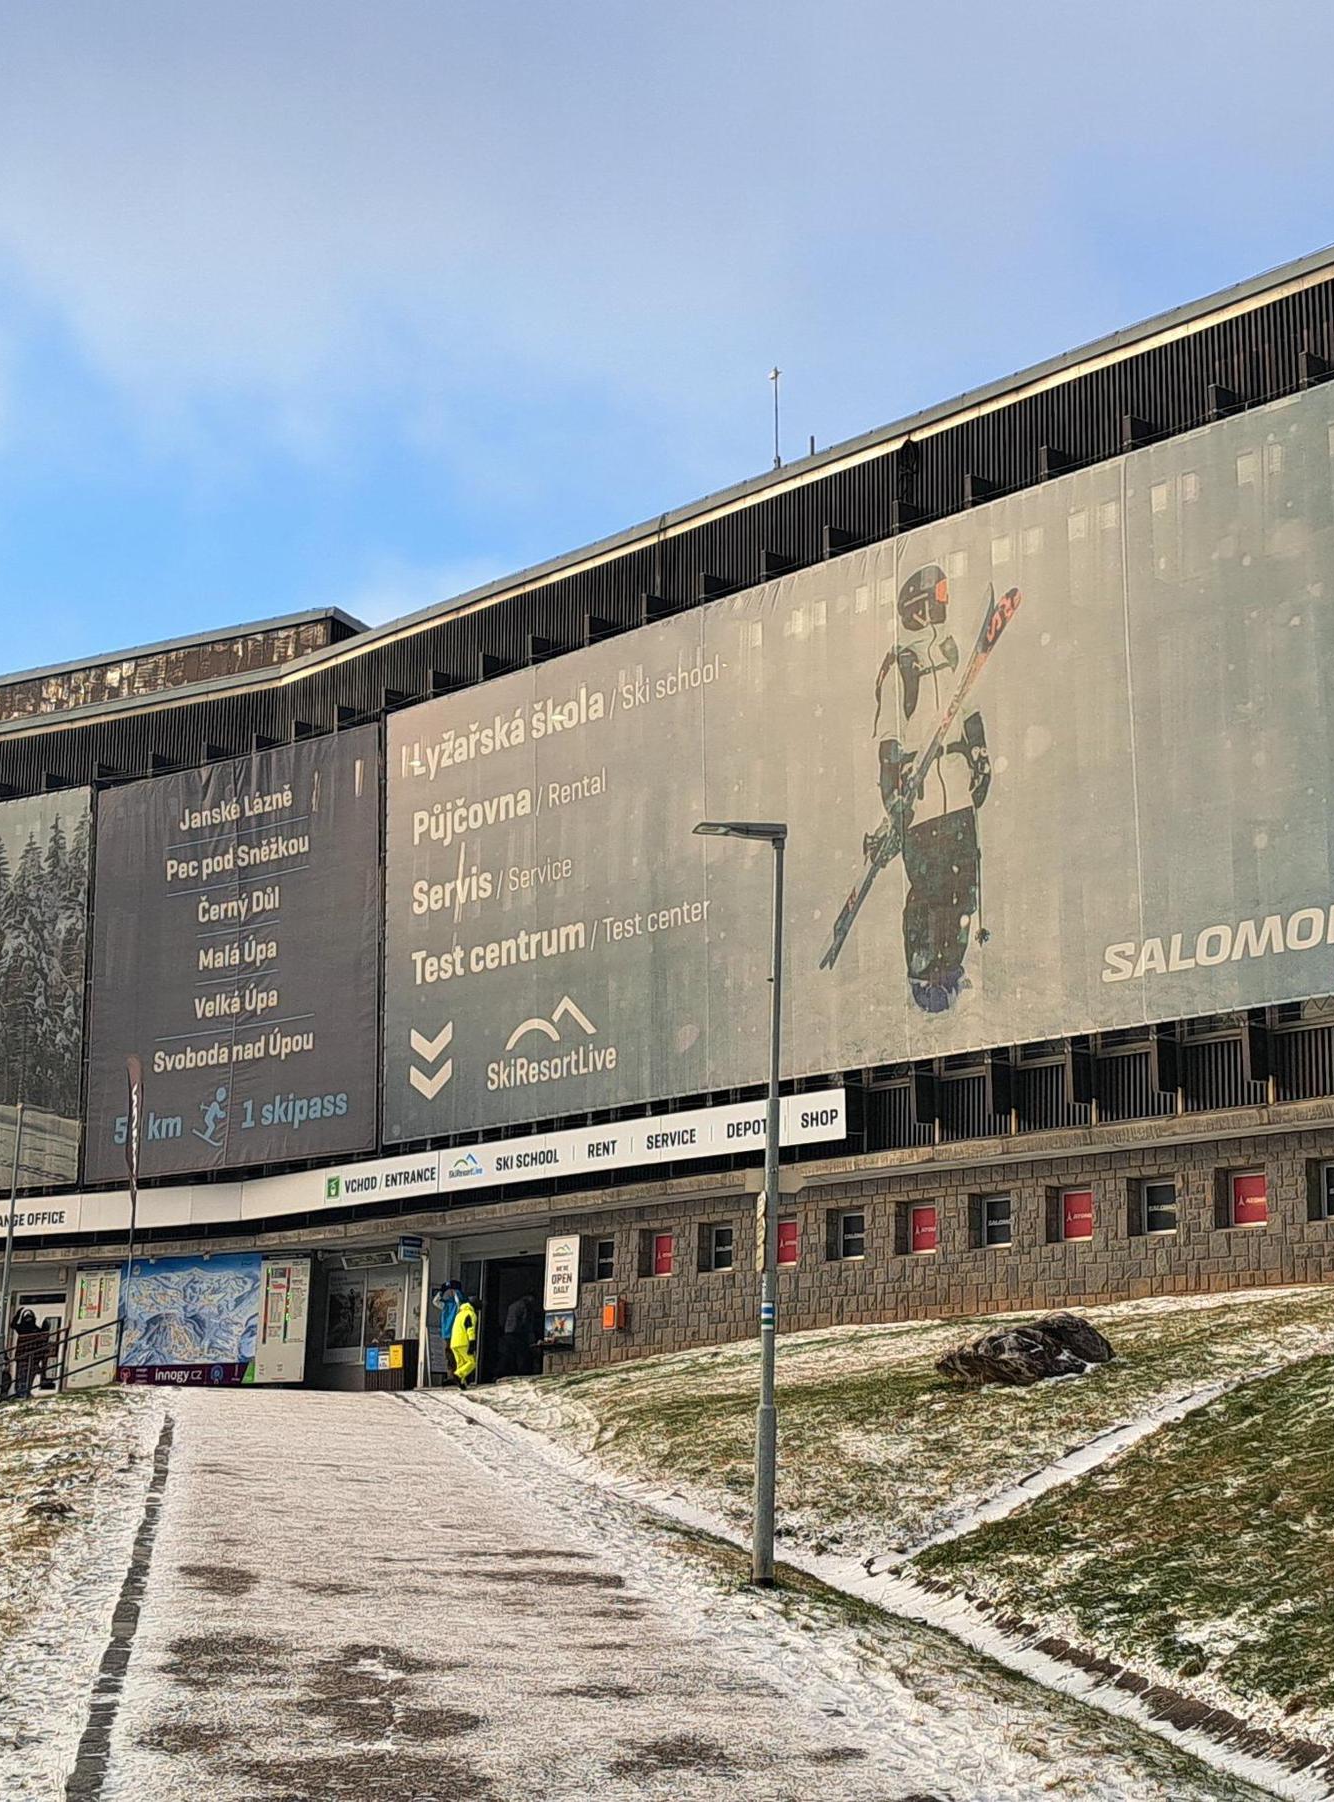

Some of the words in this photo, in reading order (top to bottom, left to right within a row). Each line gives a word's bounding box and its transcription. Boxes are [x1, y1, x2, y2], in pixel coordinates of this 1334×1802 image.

[413, 708, 526, 780] Lyžařská
[531, 686, 605, 740] škola
[621, 678, 651, 711] Ski
[655, 654, 720, 700] school
[179, 796, 240, 831] Janské
[244, 784, 293, 817] Lázně
[413, 787, 532, 847] Půjčovna
[548, 767, 606, 808] Rental
[166, 859, 199, 882] Pec
[202, 852, 235, 881] pod
[237, 835, 310, 868] Sněžkou
[198, 895, 249, 922] Černý
[252, 886, 280, 913] Důl
[412, 866, 493, 915] Servis
[508, 857, 572, 892] Service
[198, 946, 240, 971] Malá
[244, 937, 277, 966] Úpa
[411, 945, 465, 985] Test
[470, 921, 586, 974] centrum
[602, 913, 643, 944] Test
[647, 900, 712, 933] center
[194, 990, 241, 1019] Velká
[245, 983, 278, 1014] Úpa
[153, 1043, 229, 1073] Svoboda
[231, 1035, 265, 1063] nad
[268, 1027, 314, 1060] Úpou
[487, 1043, 617, 1091] SkiResortLive
[147, 1111, 183, 1140] km
[241, 1099, 256, 1129] 1
[261, 1092, 349, 1129] skipass
[800, 1108, 839, 1129] SHOP
[587, 1139, 617, 1159] RENT
[646, 1128, 696, 1150] SERVICE
[496, 1155, 514, 1172] SKI
[516, 1149, 560, 1169] SCHOOL
[344, 1177, 378, 1194] VCHOD
[385, 1166, 437, 1188] ENTRANCE
[27, 1210, 66, 1225] OFFICE
[551, 1273, 572, 1285] OPEN
[154, 1367, 189, 1383] innogy
